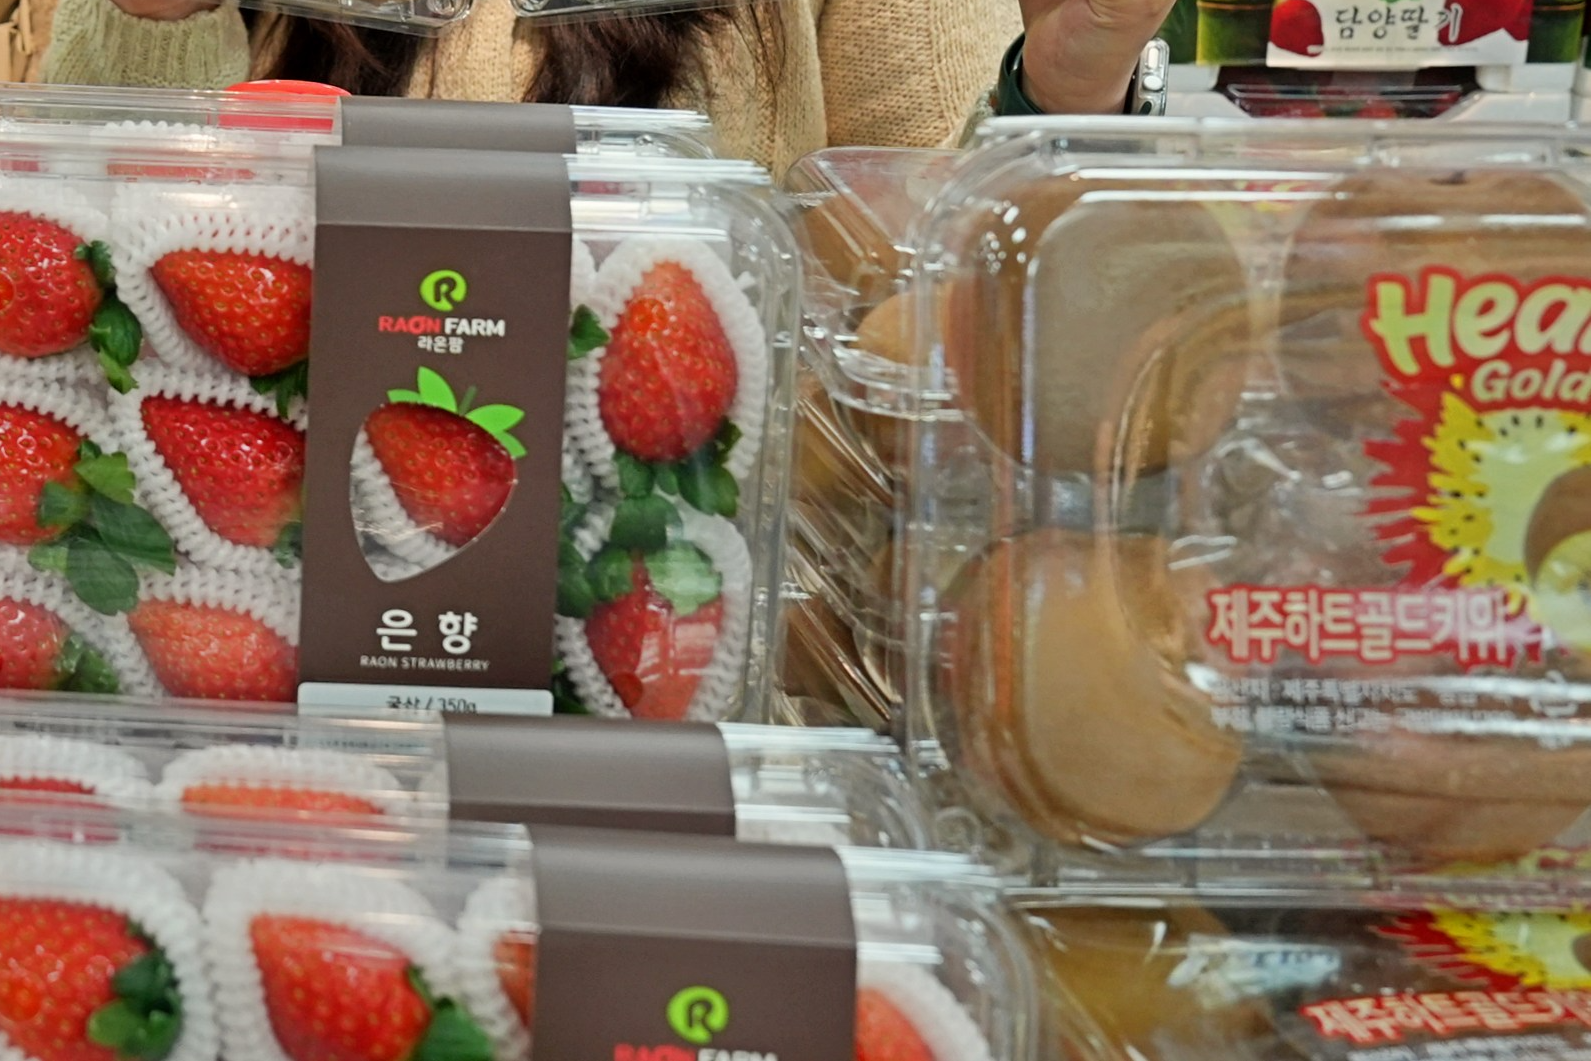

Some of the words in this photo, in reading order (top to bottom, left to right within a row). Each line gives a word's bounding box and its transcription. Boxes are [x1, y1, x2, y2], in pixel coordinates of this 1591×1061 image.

[1335, 4, 1463, 43] 담양딸기
[378, 316, 442, 334] RAON
[444, 317, 506, 337] FARM
[417, 335, 464, 354] 라온팜
[1210, 589, 1507, 660] 제주하트골드키위
[360, 655, 398, 668] RAON
[401, 657, 490, 671] STRAWBERRY
